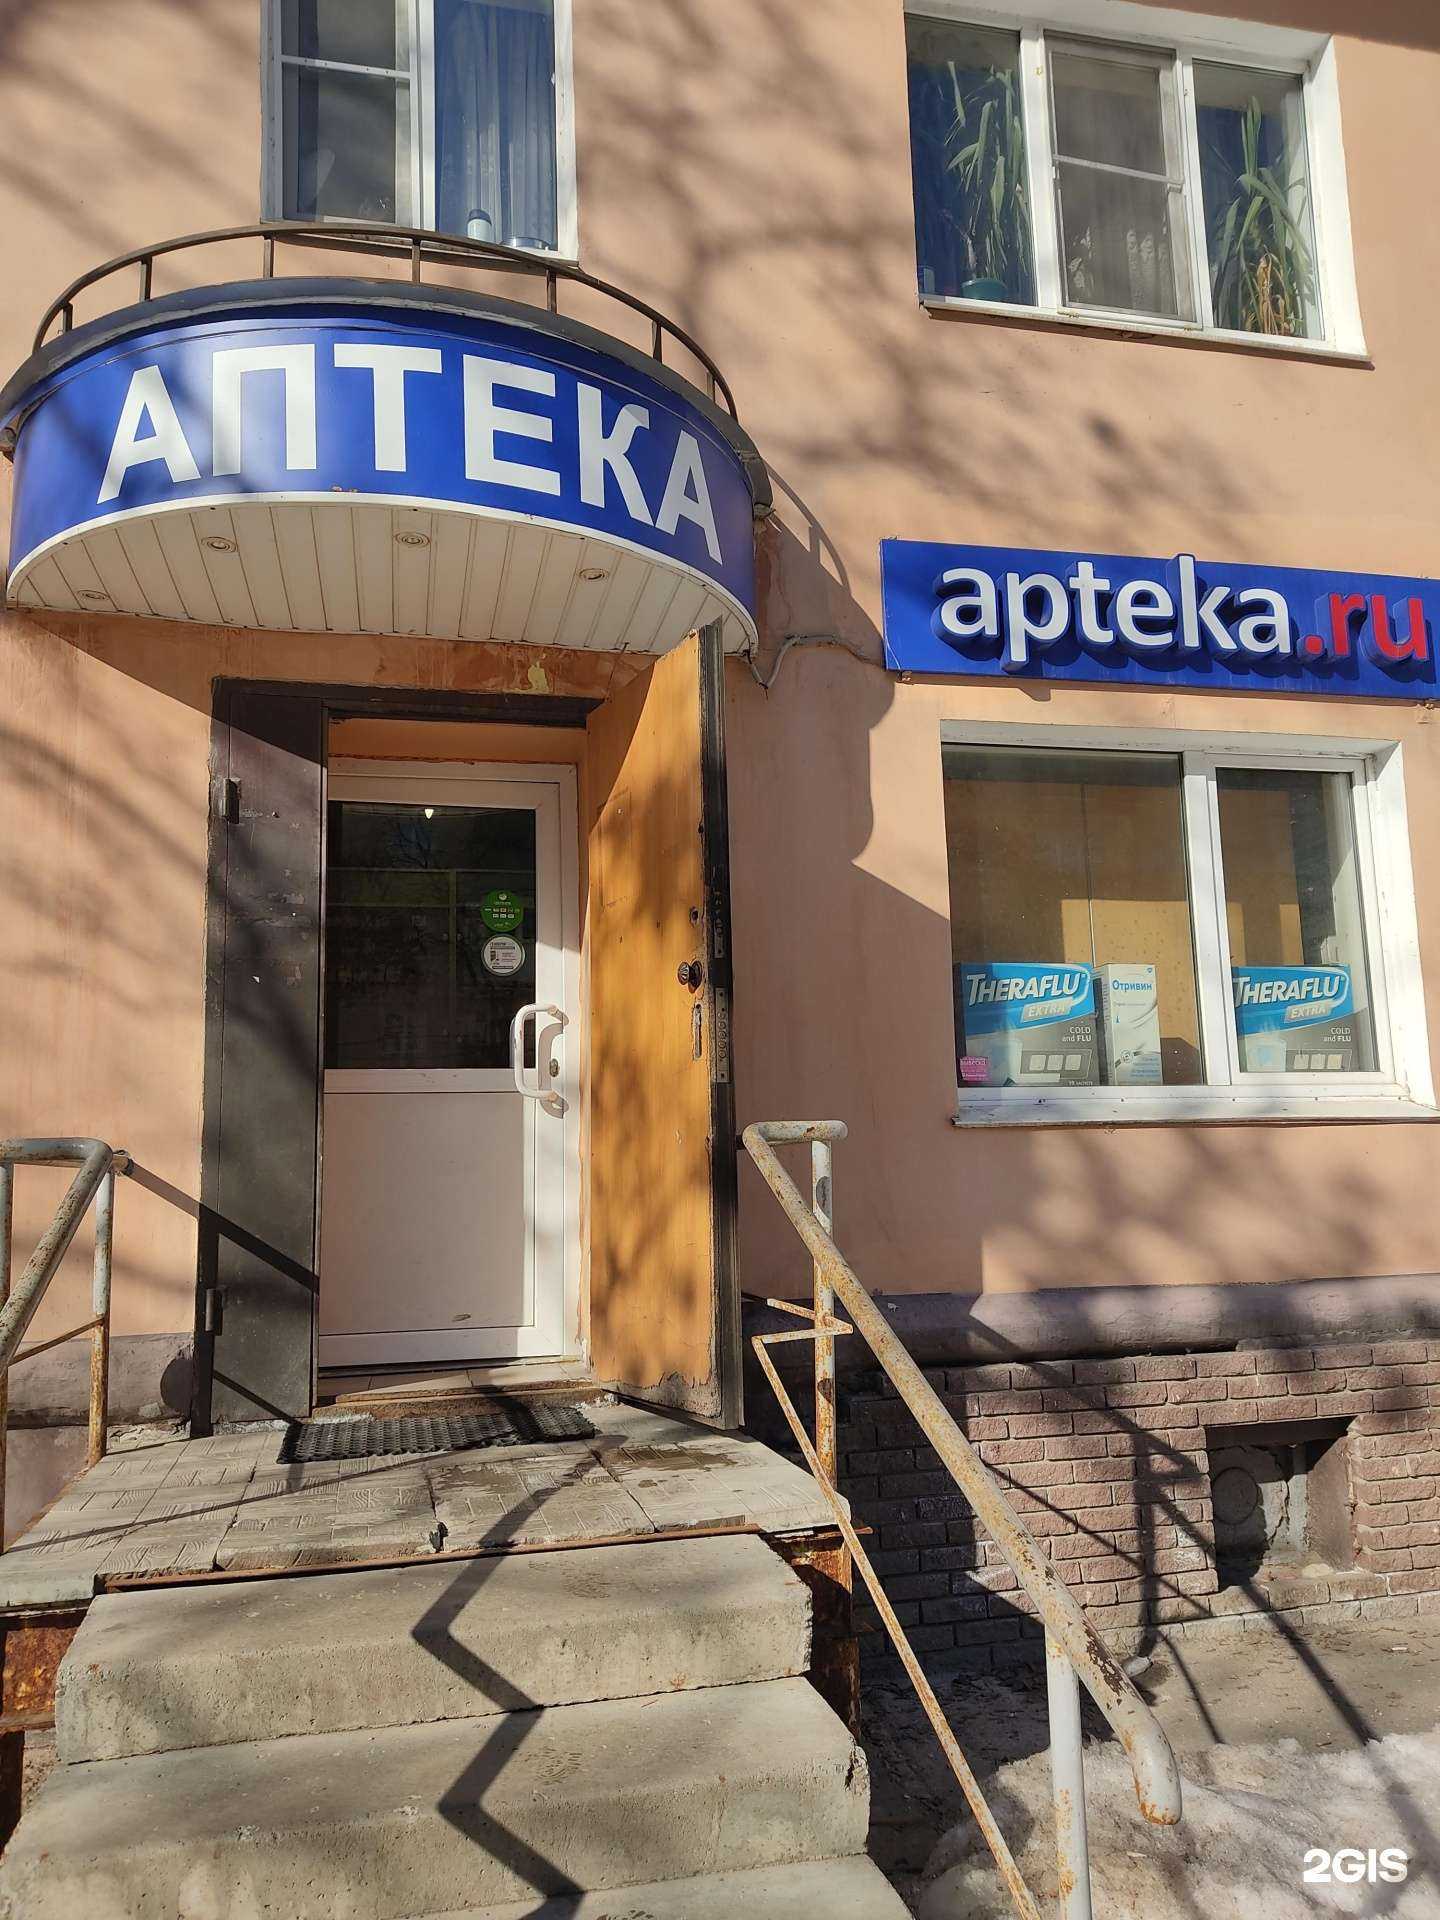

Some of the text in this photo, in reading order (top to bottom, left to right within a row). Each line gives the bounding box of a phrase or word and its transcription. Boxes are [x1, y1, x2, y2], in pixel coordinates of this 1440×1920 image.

[97, 343, 723, 566] АПТЕКА
[938, 553, 1429, 662] apteka.ru
[1112, 979, 1153, 992] Отривин
[1069, 1026, 1091, 1035] COLD
[1330, 1027, 1351, 1036] COLD
[1062, 1034, 1092, 1043] and FLU
[1323, 1035, 1336, 1043] and
